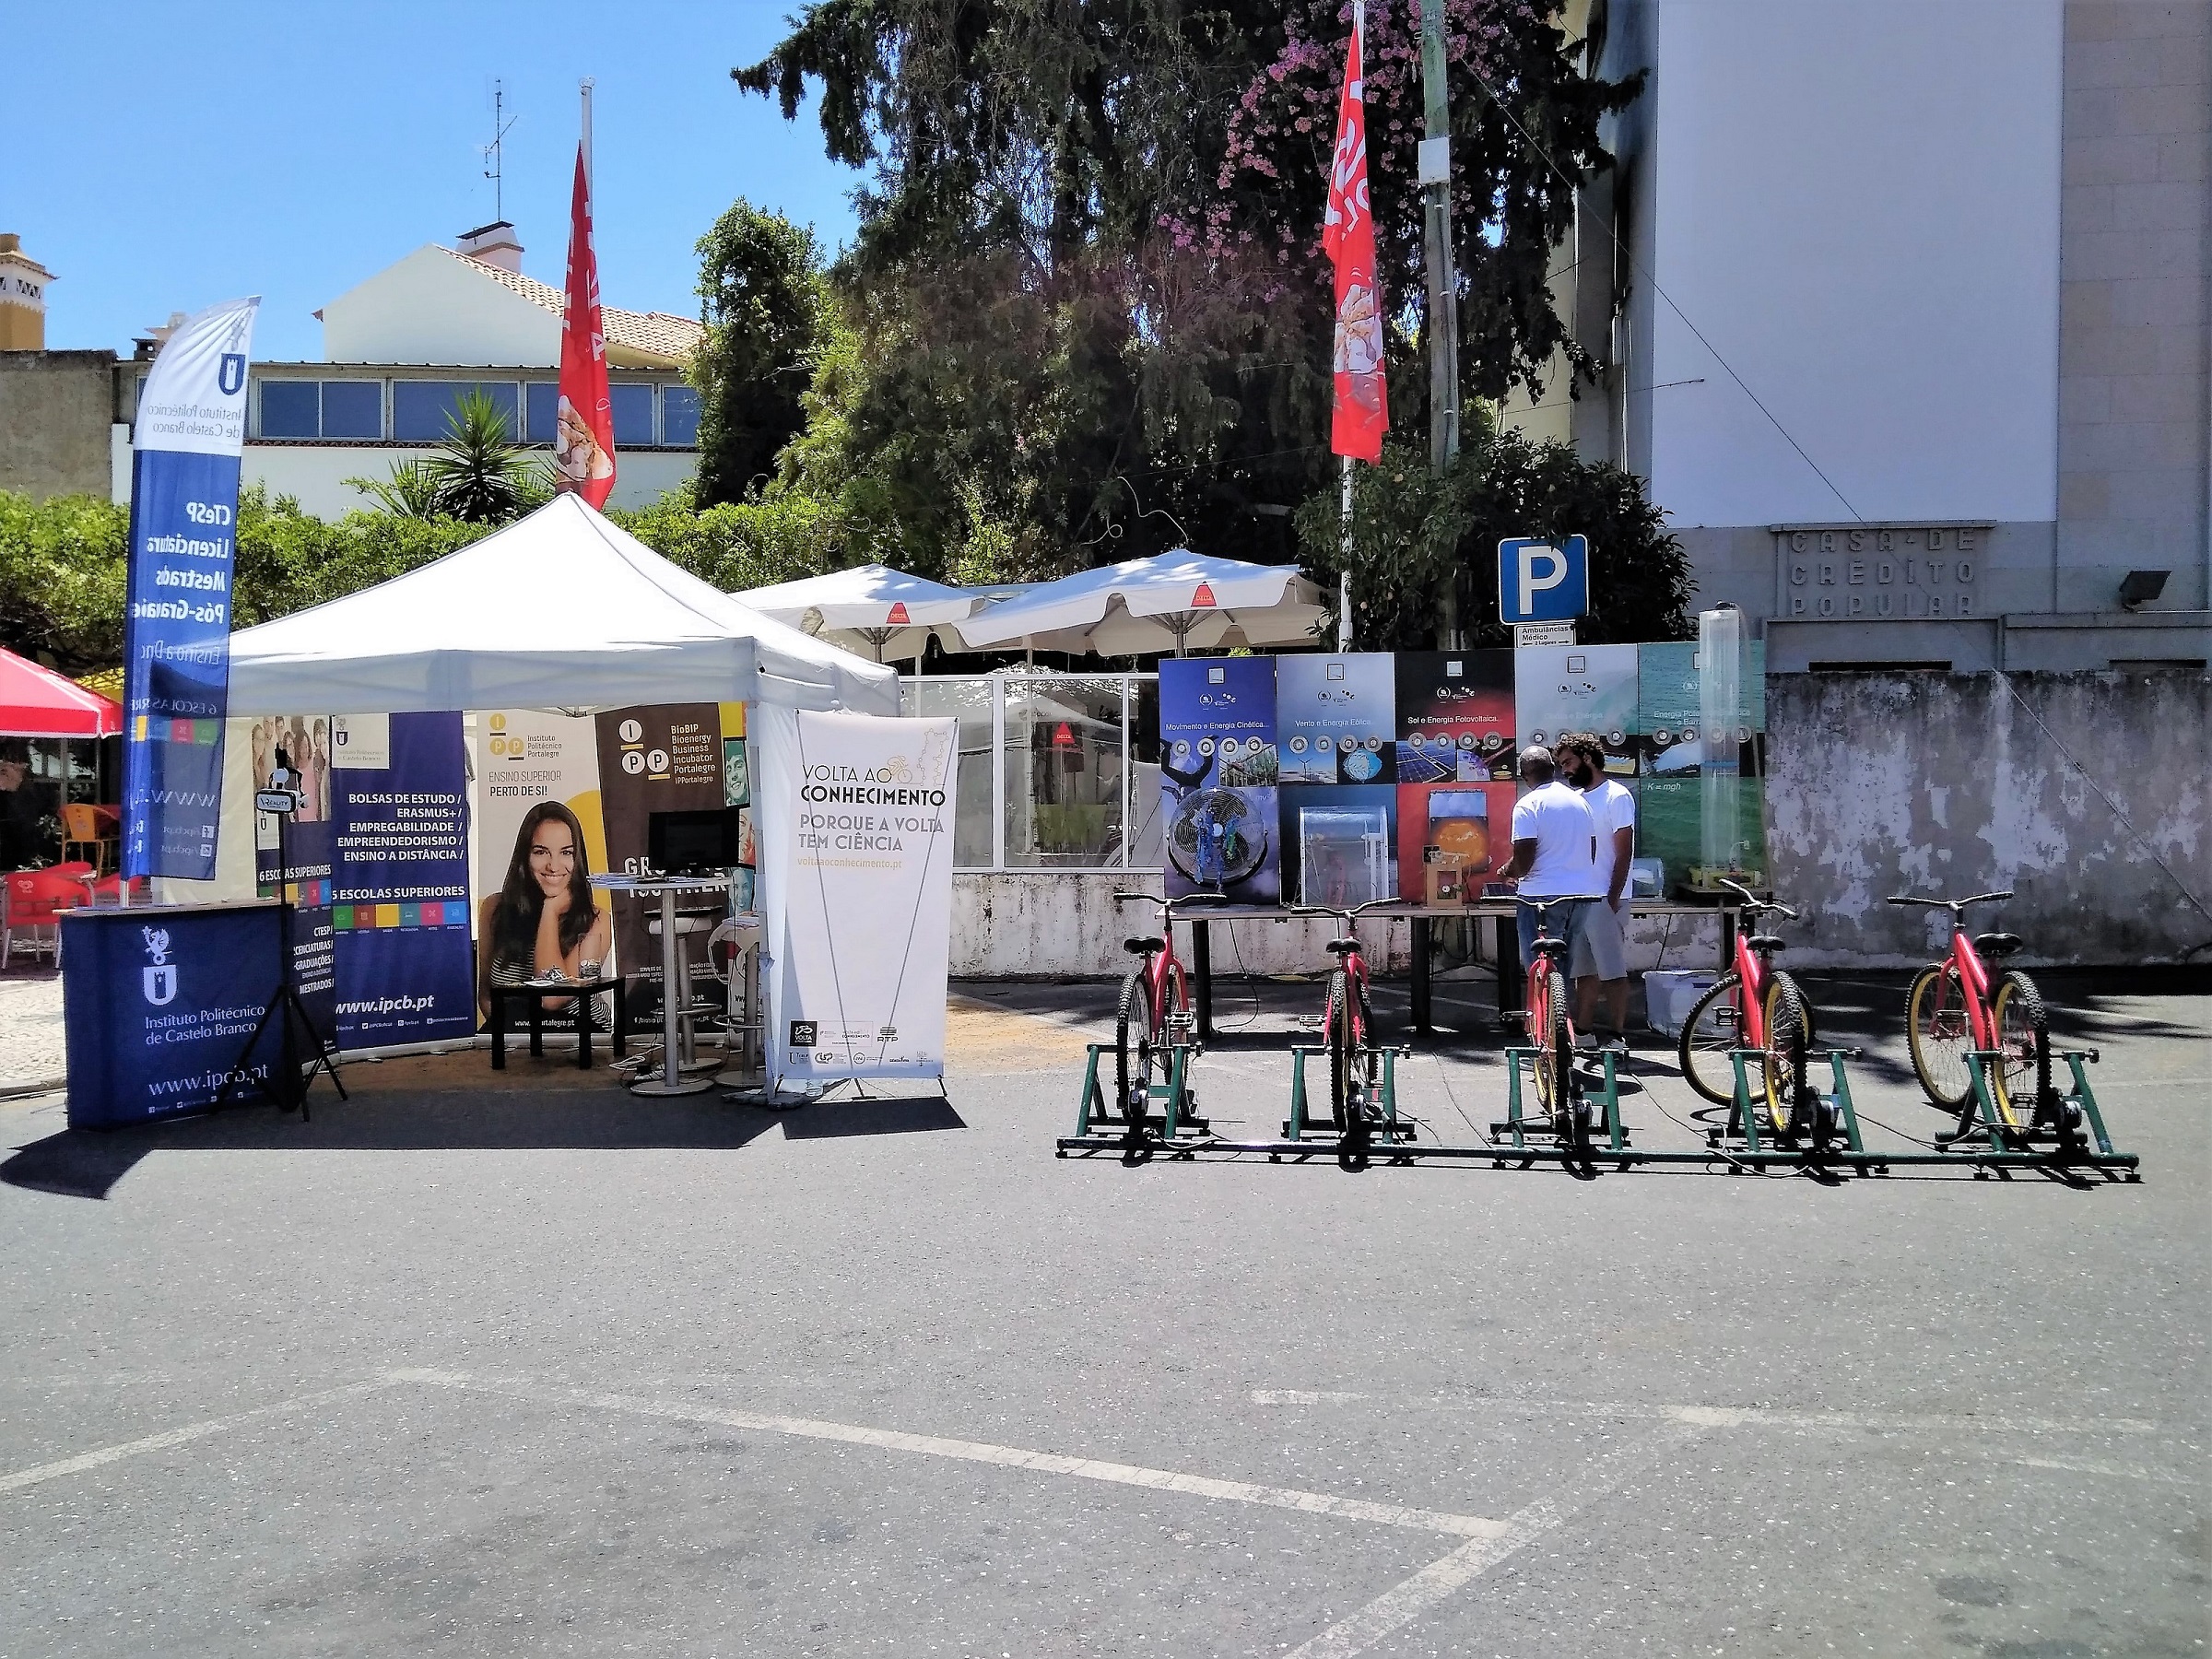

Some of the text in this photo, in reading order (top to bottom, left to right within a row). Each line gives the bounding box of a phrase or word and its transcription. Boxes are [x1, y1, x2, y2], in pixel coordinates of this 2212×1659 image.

[1791, 529, 1973, 553] CASA DE
[1791, 559, 1974, 585] CREDITO
[1519, 546, 1568, 615] P
[1165, 723, 1203, 731] Movimento
[1209, 722, 1236, 730] Energia
[1323, 719, 1348, 727] Energia
[1427, 716, 1454, 725] Energia
[671, 724, 699, 735] BioBIP
[671, 735, 712, 745] Bioenergy
[527, 750, 559, 759] Portalegre
[673, 745, 709, 754] Business
[674, 754, 713, 764] Incubator
[675, 763, 716, 774] Portalegre
[802, 765, 892, 783] VOLTA AO
[488, 771, 562, 782] ENSINO SUPERIOR
[490, 785, 547, 797] PERTO DE SI!
[801, 785, 947, 806] CONHECIMENTO
[348, 794, 393, 805] BOLSAS
[395, 794, 408, 804] DE
[409, 794, 455, 805] ESTUDO
[396, 807, 456, 818] ERASMUS+
[350, 822, 454, 833] EMPREGABILIDADE
[800, 814, 945, 833] PORQUE A VOLTA
[337, 836, 457, 848] EMPREENDEDORISMO
[798, 831, 903, 852] TEM CIÊNCIA
[344, 852, 386, 862] ENSINO
[388, 851, 397, 861] A
[398, 849, 457, 861] DISTÂNCIA
[259, 871, 265, 882] 6
[295, 865, 332, 877] SUPERIORES
[340, 888, 393, 900] ESCOLAS
[394, 886, 465, 899] SUPERIORES
[313, 925, 330, 937] CTESP
[300, 980, 332, 994] MESTRADOS
[335, 994, 436, 1015] www.ipcb.pt
[146, 1005, 266, 1030] Instituto Politécnico
[146, 1021, 257, 1045] de Castelo Branco
